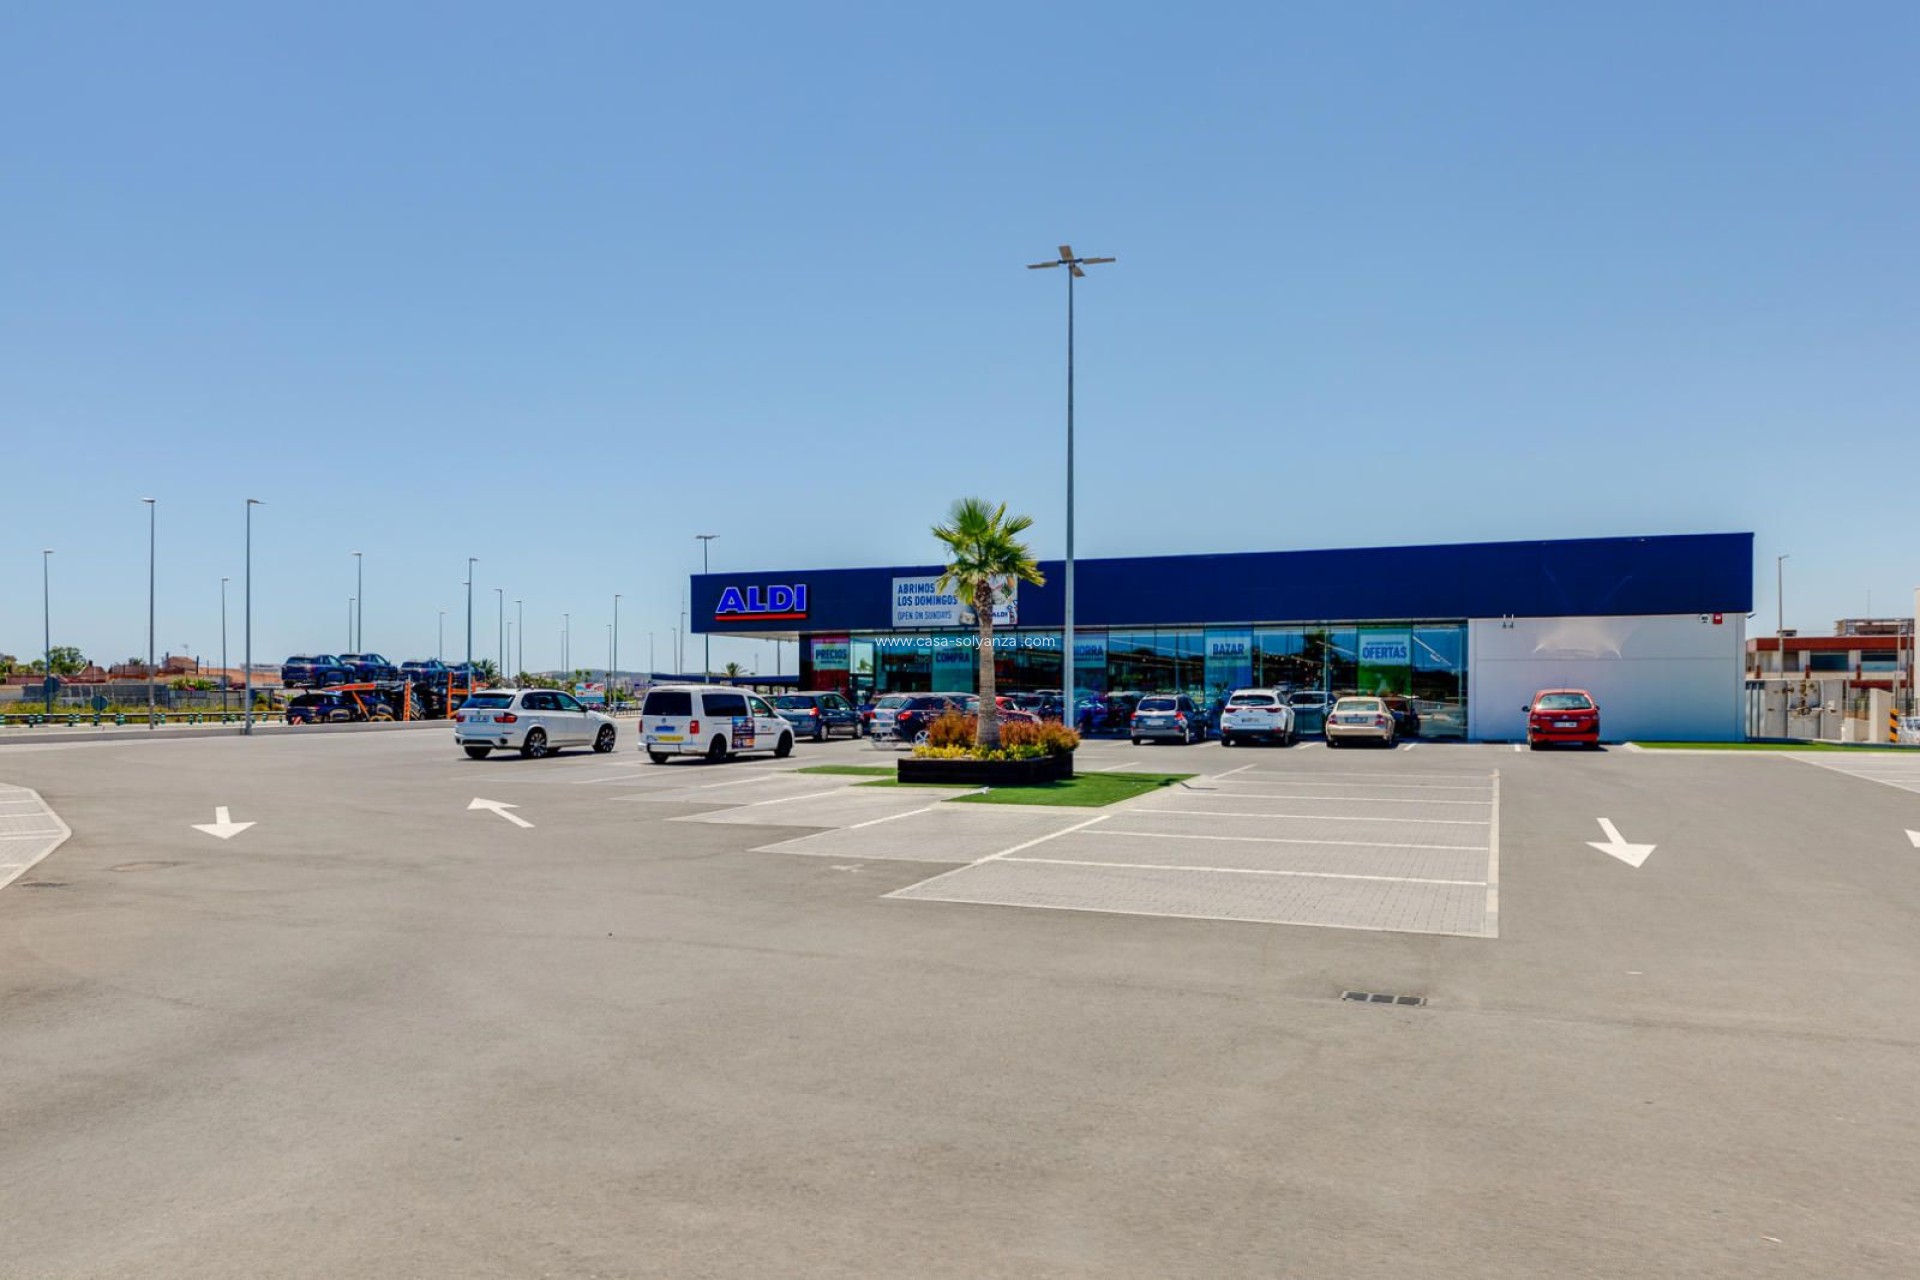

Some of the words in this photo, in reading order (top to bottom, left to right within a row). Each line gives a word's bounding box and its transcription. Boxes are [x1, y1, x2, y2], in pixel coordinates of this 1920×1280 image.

[898, 583, 935, 594] ABRIMOS
[715, 584, 807, 613] ALDI
[898, 595, 912, 607] LOS
[915, 595, 958, 606] DOMINGOS
[898, 611, 913, 620] OPEN
[914, 611, 923, 620] ON
[925, 611, 952, 620] SUNDAYS
[815, 648, 848, 660] PRECIOS
[1212, 643, 1244, 655] BAZAR
[1362, 646, 1408, 659] OFERTAS
[935, 652, 970, 663] COMPRA
